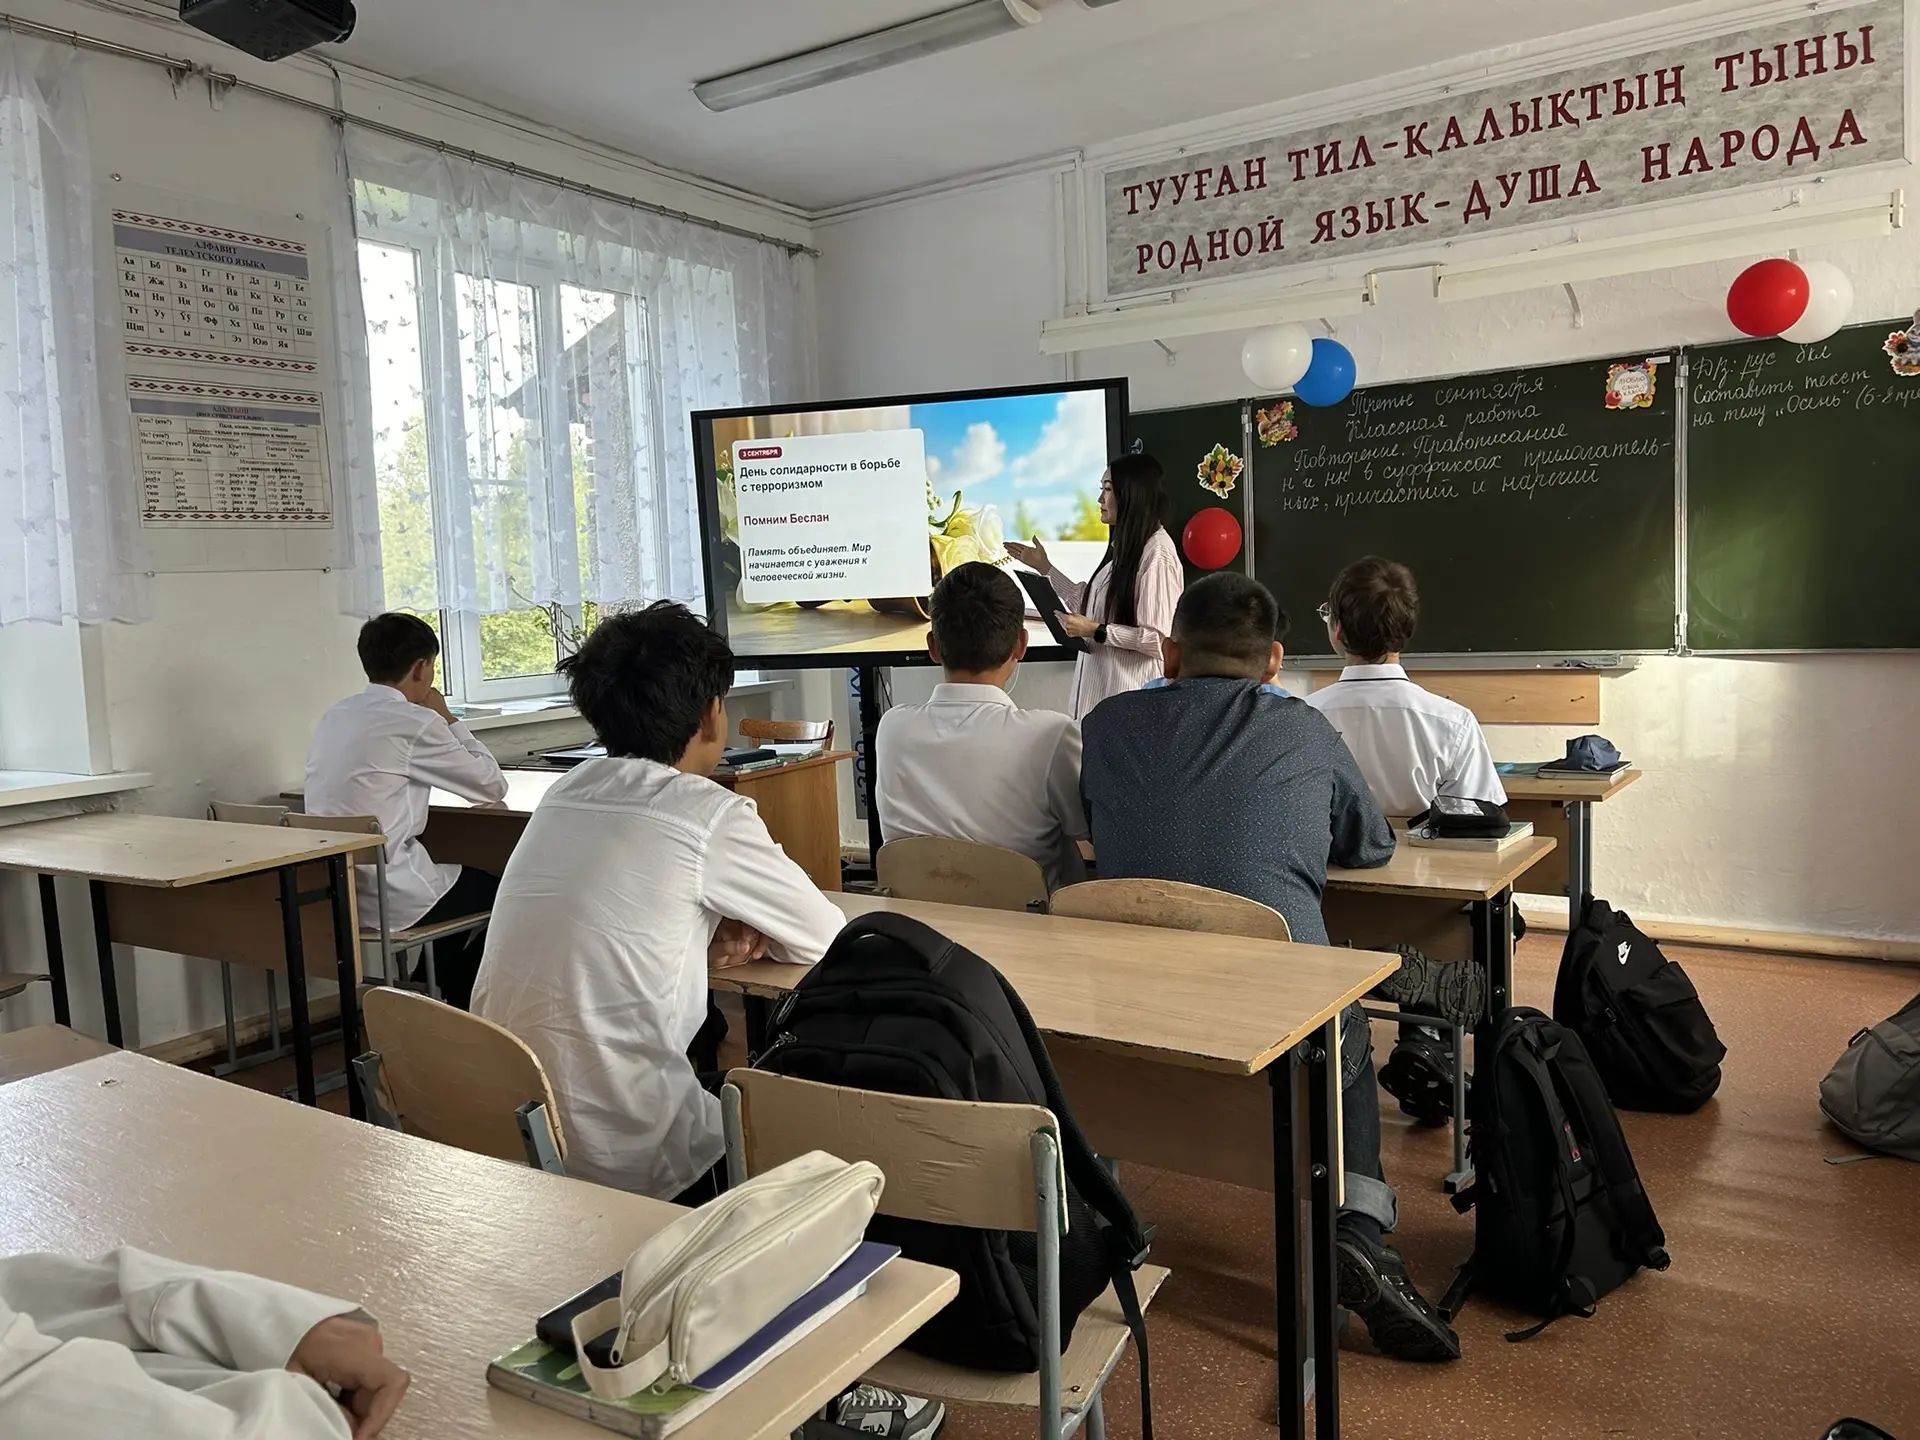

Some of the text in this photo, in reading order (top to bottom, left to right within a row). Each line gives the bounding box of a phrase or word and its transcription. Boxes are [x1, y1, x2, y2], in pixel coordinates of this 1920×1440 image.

[1714, 25, 1876, 94] ТЫНЫ
[1137, 216, 1285, 275] РОДНОЙ
[1641, 108, 1867, 184] НАРОДА
[166, 246, 266, 269] ТЕЛЕУТСКОГО ЯЗЫКА
[194, 241, 238, 254] АЛФАВИТ
[150, 261, 161, 269] Бб
[1740, 351, 1776, 381] рус
[1693, 370, 1870, 405] Составить текст
[1347, 391, 1414, 424] Третье
[1693, 411, 1715, 427] на
[1724, 402, 1766, 427] тему
[1347, 401, 1543, 442] Классная работа
[747, 449, 778, 457] СЕНТЯБРЯ
[1413, 422, 1569, 467] Правописание
[740, 458, 901, 478] День солидарности в борьбе
[1301, 475, 1315, 488] и
[1324, 467, 1348, 489] нн
[1364, 459, 1374, 481] в
[1382, 453, 1502, 492] суффиксах
[741, 480, 823, 493] с терроризмом
[1334, 478, 1459, 516] причастий
[1471, 480, 1487, 495] и
[1501, 463, 1600, 500] наречий
[744, 513, 829, 526] Помним Беслан
[748, 543, 872, 557] Память объединяет. Мир
[749, 561, 805, 570] начинается
[815, 558, 860, 569] уважения
[861, 557, 867, 565] к
[750, 570, 847, 582] человеческой жизни.
